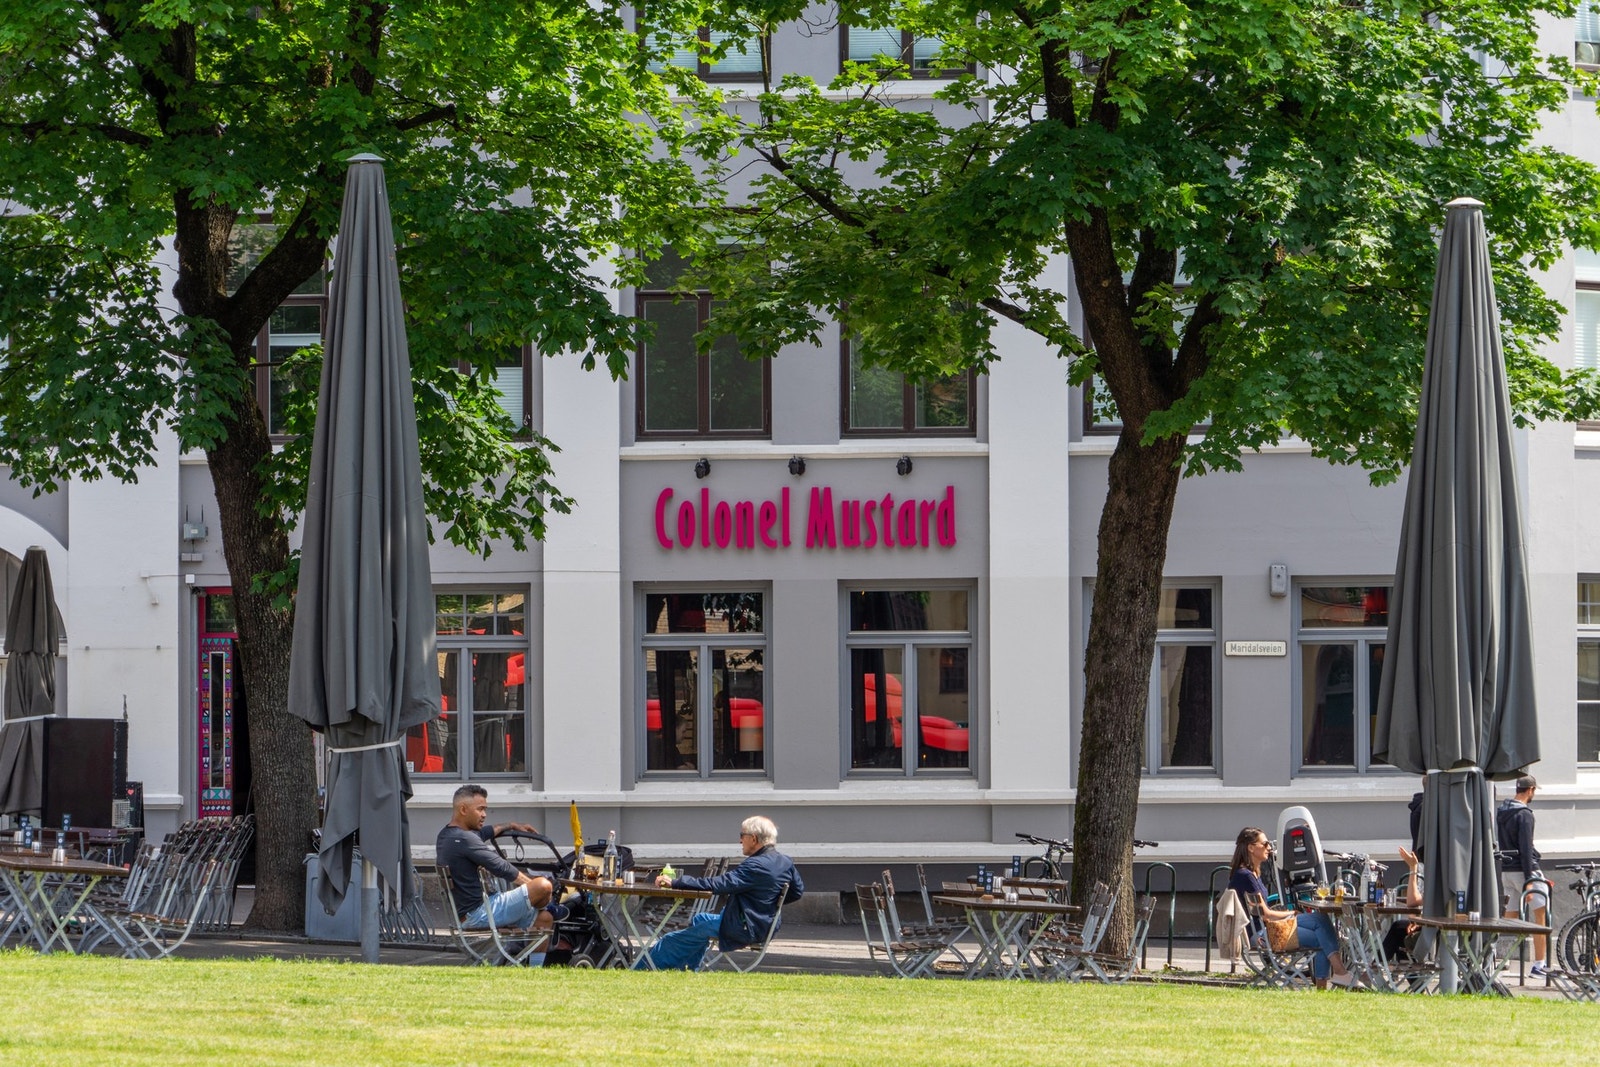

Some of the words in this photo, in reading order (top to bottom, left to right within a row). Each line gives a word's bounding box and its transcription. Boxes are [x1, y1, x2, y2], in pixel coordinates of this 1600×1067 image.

[655, 486, 791, 549] Colonel
[806, 485, 956, 549] Mustard
[1230, 643, 1282, 653] Maridalsveien
